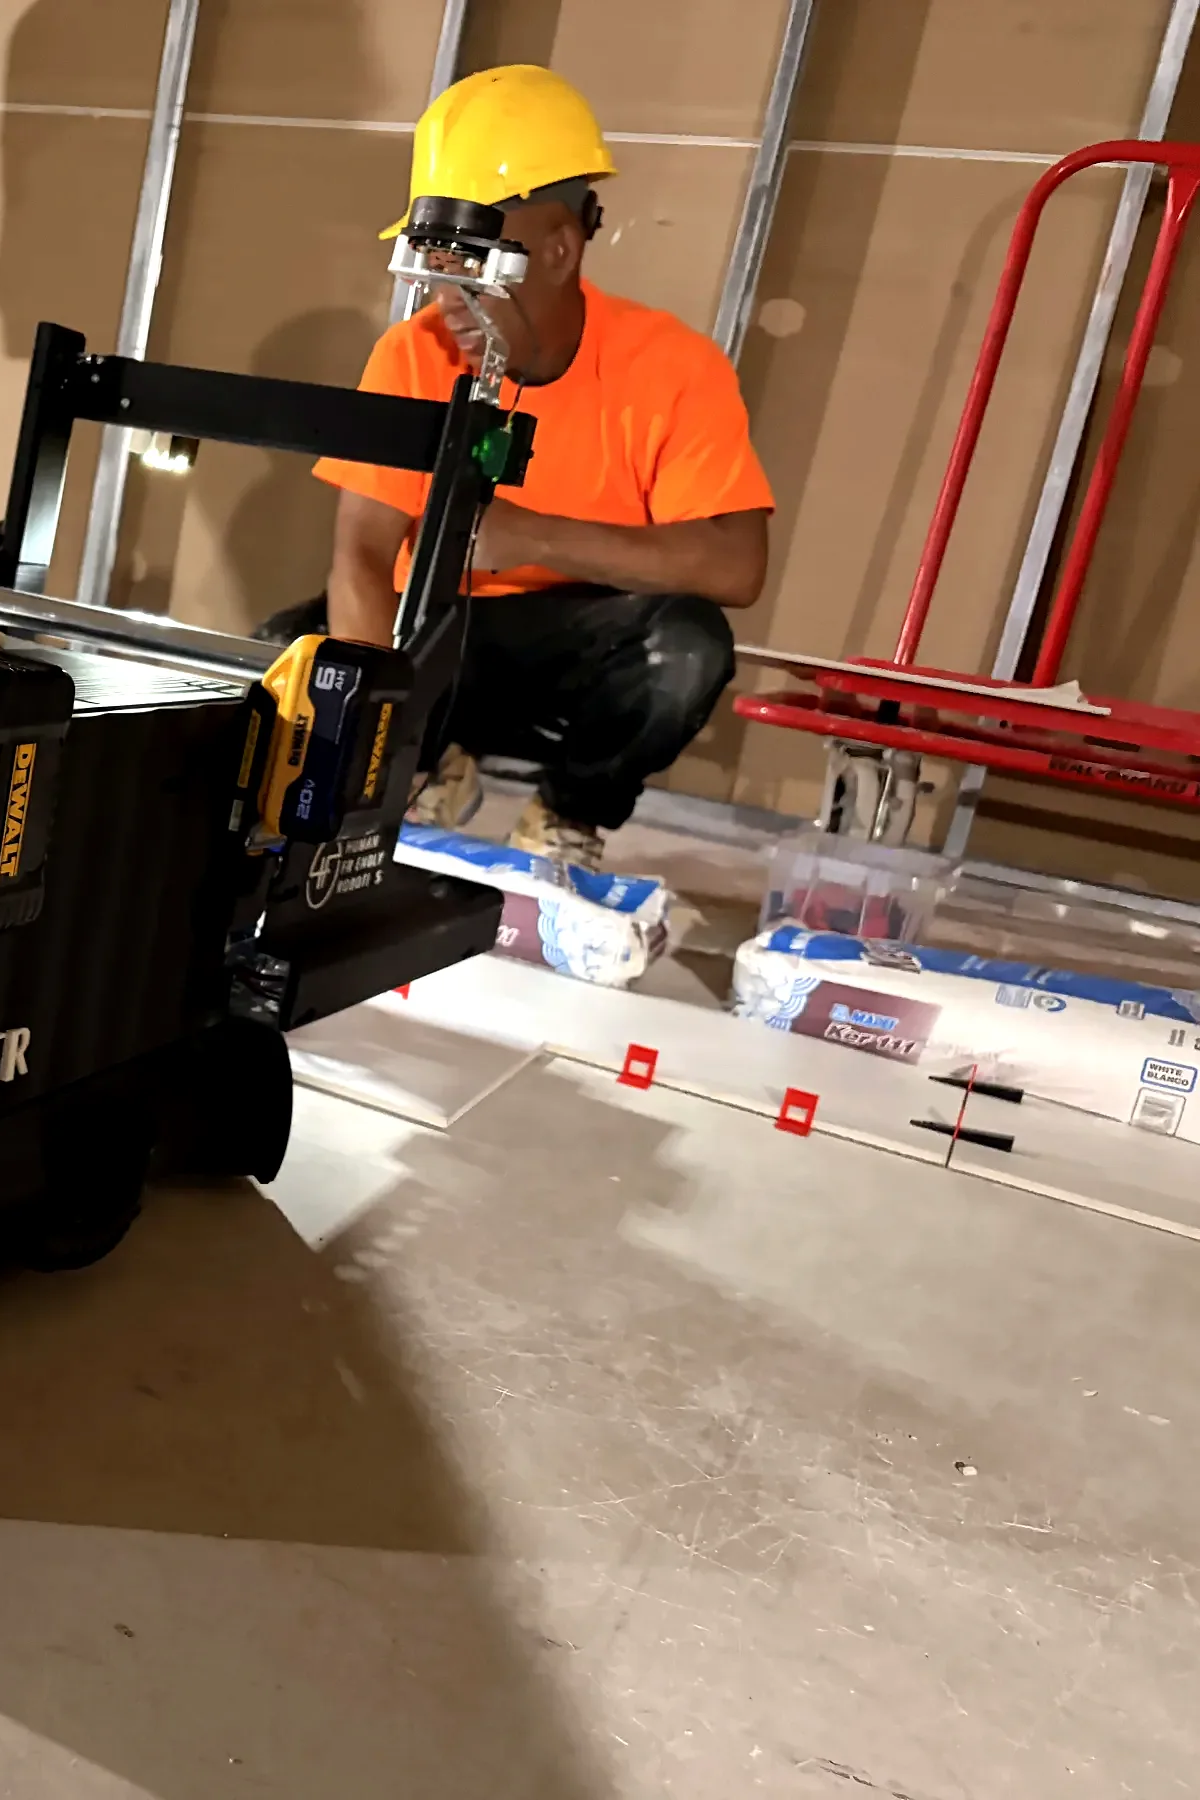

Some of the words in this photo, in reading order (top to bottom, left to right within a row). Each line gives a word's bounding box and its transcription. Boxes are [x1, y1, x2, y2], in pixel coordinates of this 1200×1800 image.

[315, 666, 336, 690] 6
[297, 779, 316, 820] 20V
[1146, 1070, 1190, 1088] BLANCO
[1149, 1062, 1184, 1078] WHITE
